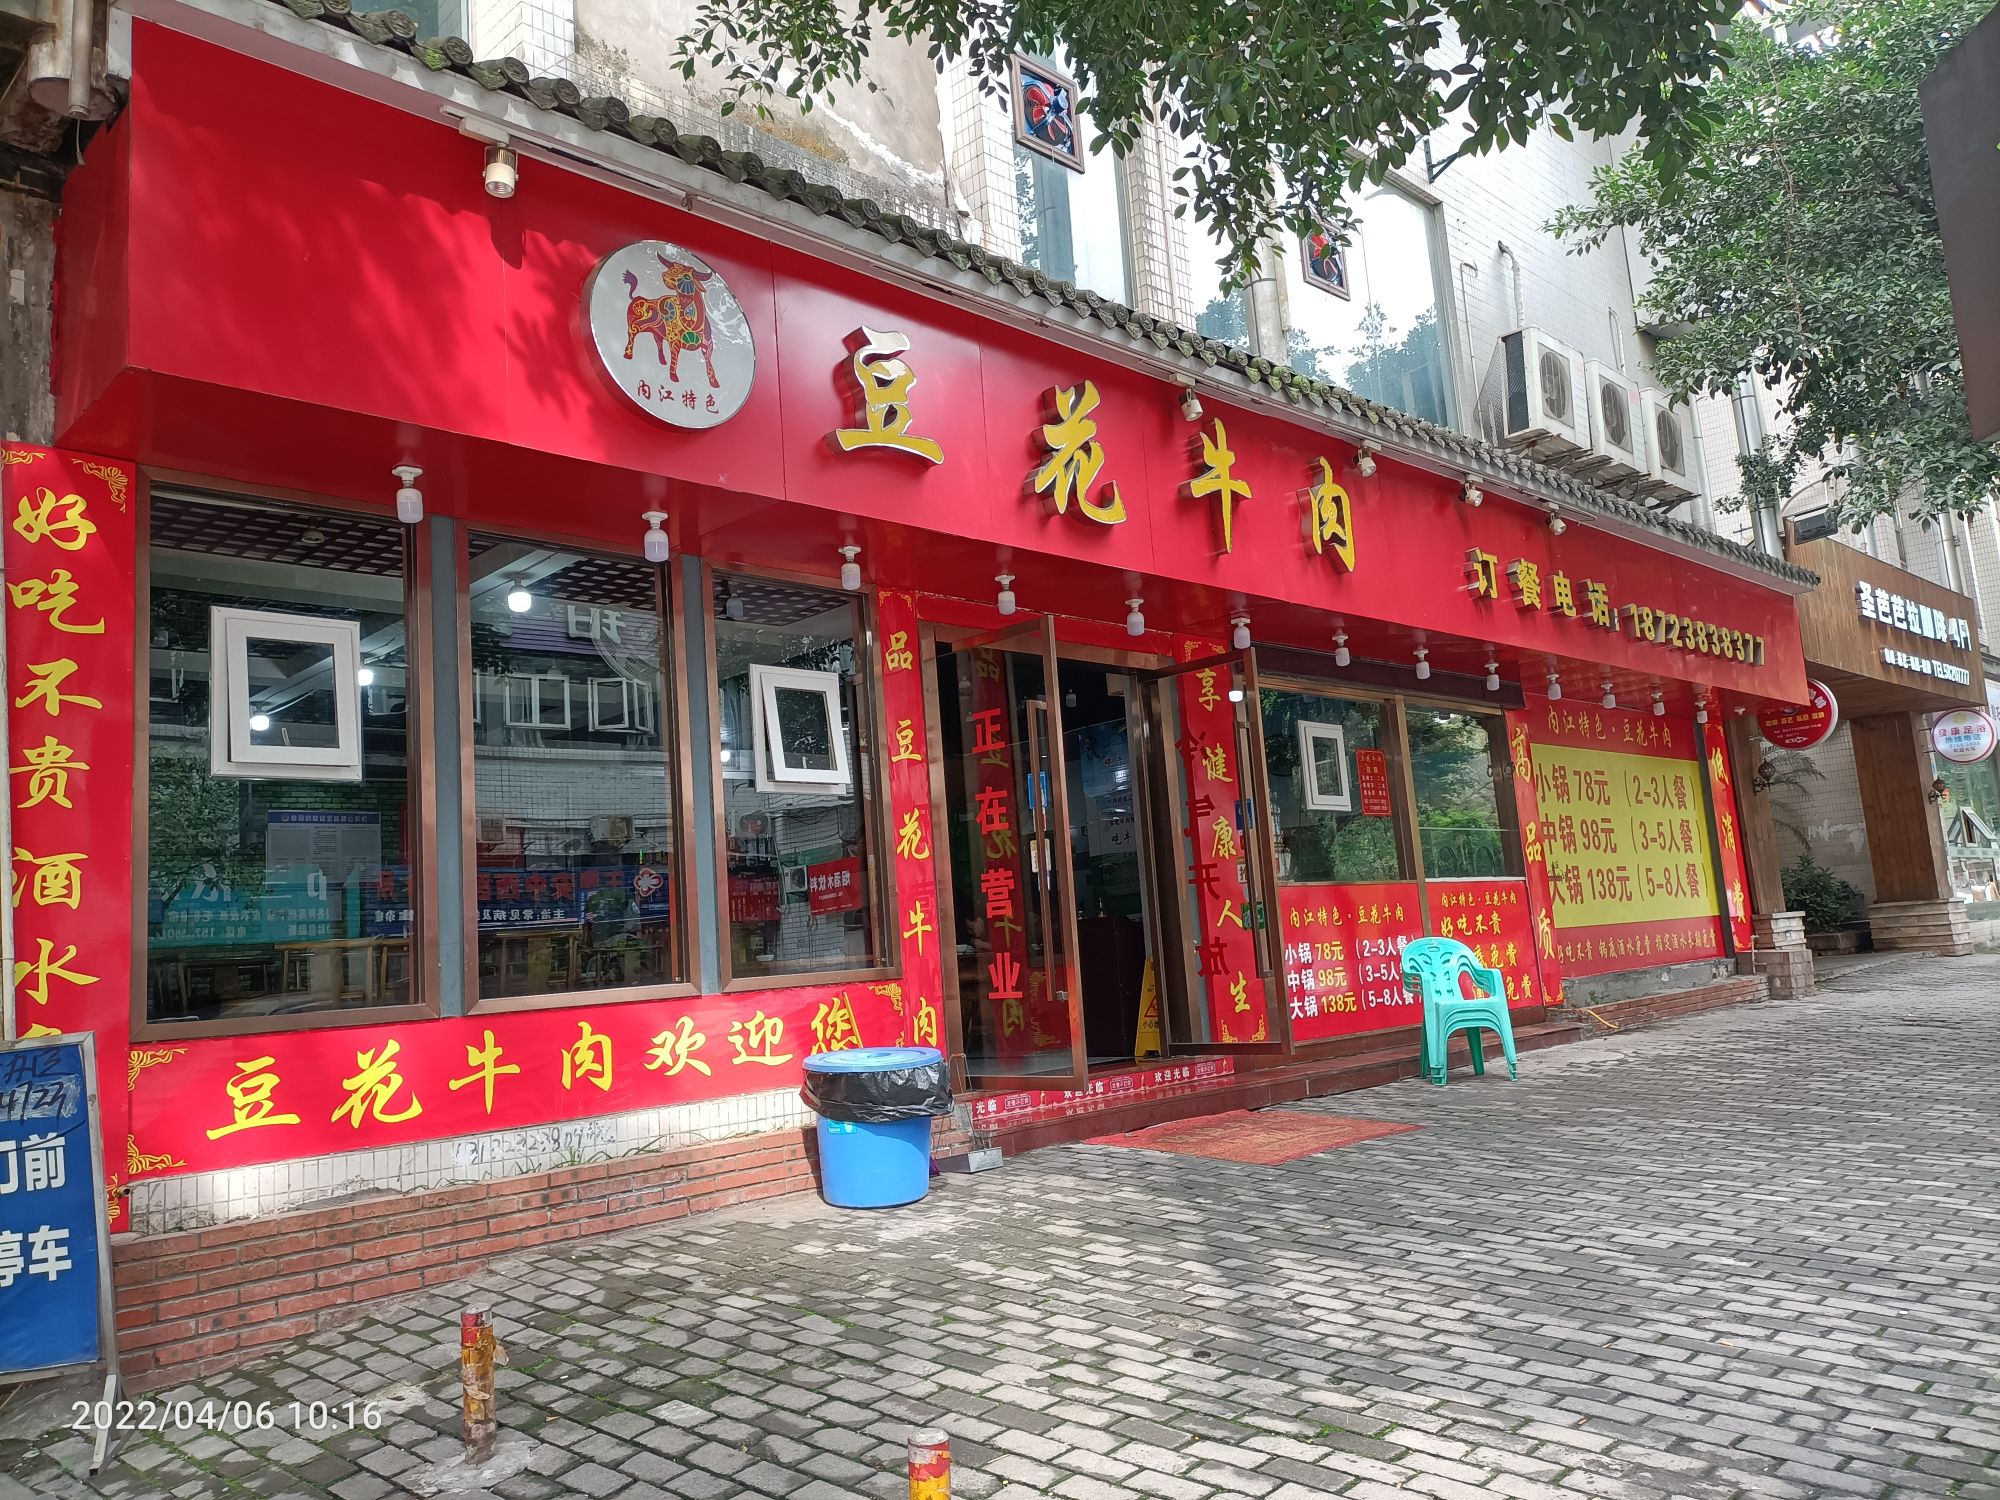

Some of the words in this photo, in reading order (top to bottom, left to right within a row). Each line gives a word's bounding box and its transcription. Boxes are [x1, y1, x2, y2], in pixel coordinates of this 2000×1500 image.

[637, 379, 719, 413] 内江特色
[835, 324, 1356, 573] 豆花牛肉
[1630, 603, 1765, 667] 18723838377
[6, 486, 105, 1040] 好吃不贵酒水
[1536, 763, 1571, 804] 小锅
[1573, 769, 1611, 806] 78元
[885, 630, 939, 1048] 品豆花牛肉
[971, 708, 1023, 1000] 正在营业
[1195, 667, 1251, 1013] 享健康人生
[1511, 726, 1555, 961] 高品质
[1540, 813, 1578, 855] 中锅
[1580, 817, 1617, 855] 98元
[1711, 746, 1747, 925] 低消费
[1548, 863, 1584, 906] 大锅
[1586, 865, 1633, 902] 138元
[1441, 910, 1502, 938] 好吃不贵
[1285, 942, 1312, 966] 小锅
[1314, 940, 1344, 961] 78元
[1287, 968, 1316, 993] 中锅
[1318, 966, 1347, 988] 98元
[1289, 995, 1319, 1020] 大锅
[1321, 992, 1357, 1014] 138元
[206, 996, 860, 1141] 豆花牛肉欢迎您
[1154, 1065, 1191, 1083] 欢迎光临
